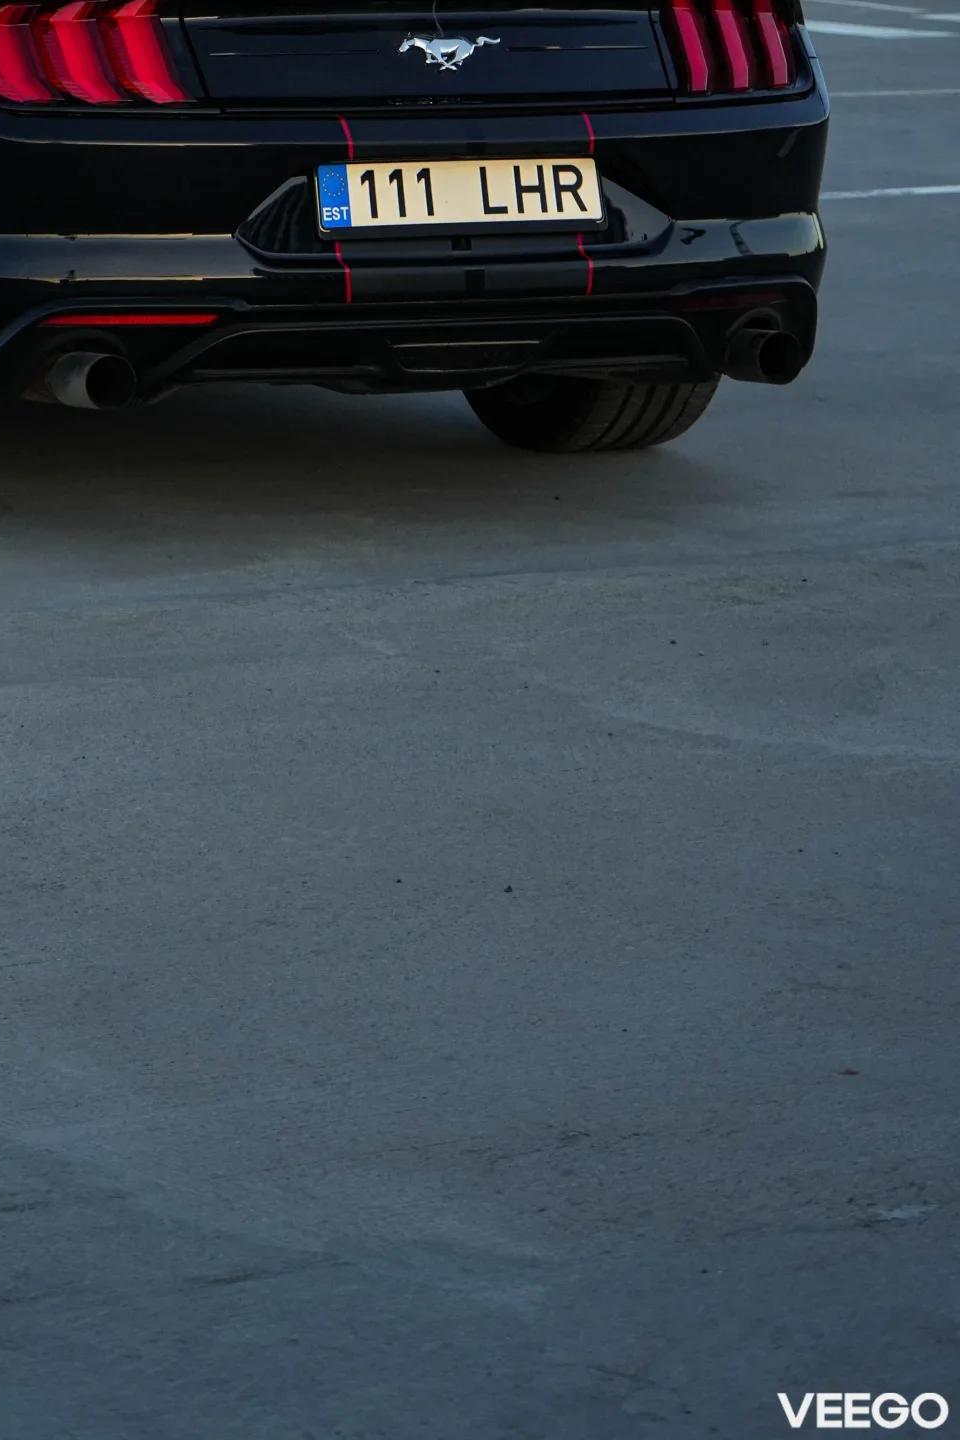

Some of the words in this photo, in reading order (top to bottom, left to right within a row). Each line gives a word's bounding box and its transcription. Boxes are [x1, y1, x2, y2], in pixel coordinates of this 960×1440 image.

[360, 167, 435, 219] 111
[479, 164, 588, 215] LHR
[322, 206, 349, 221] EST
